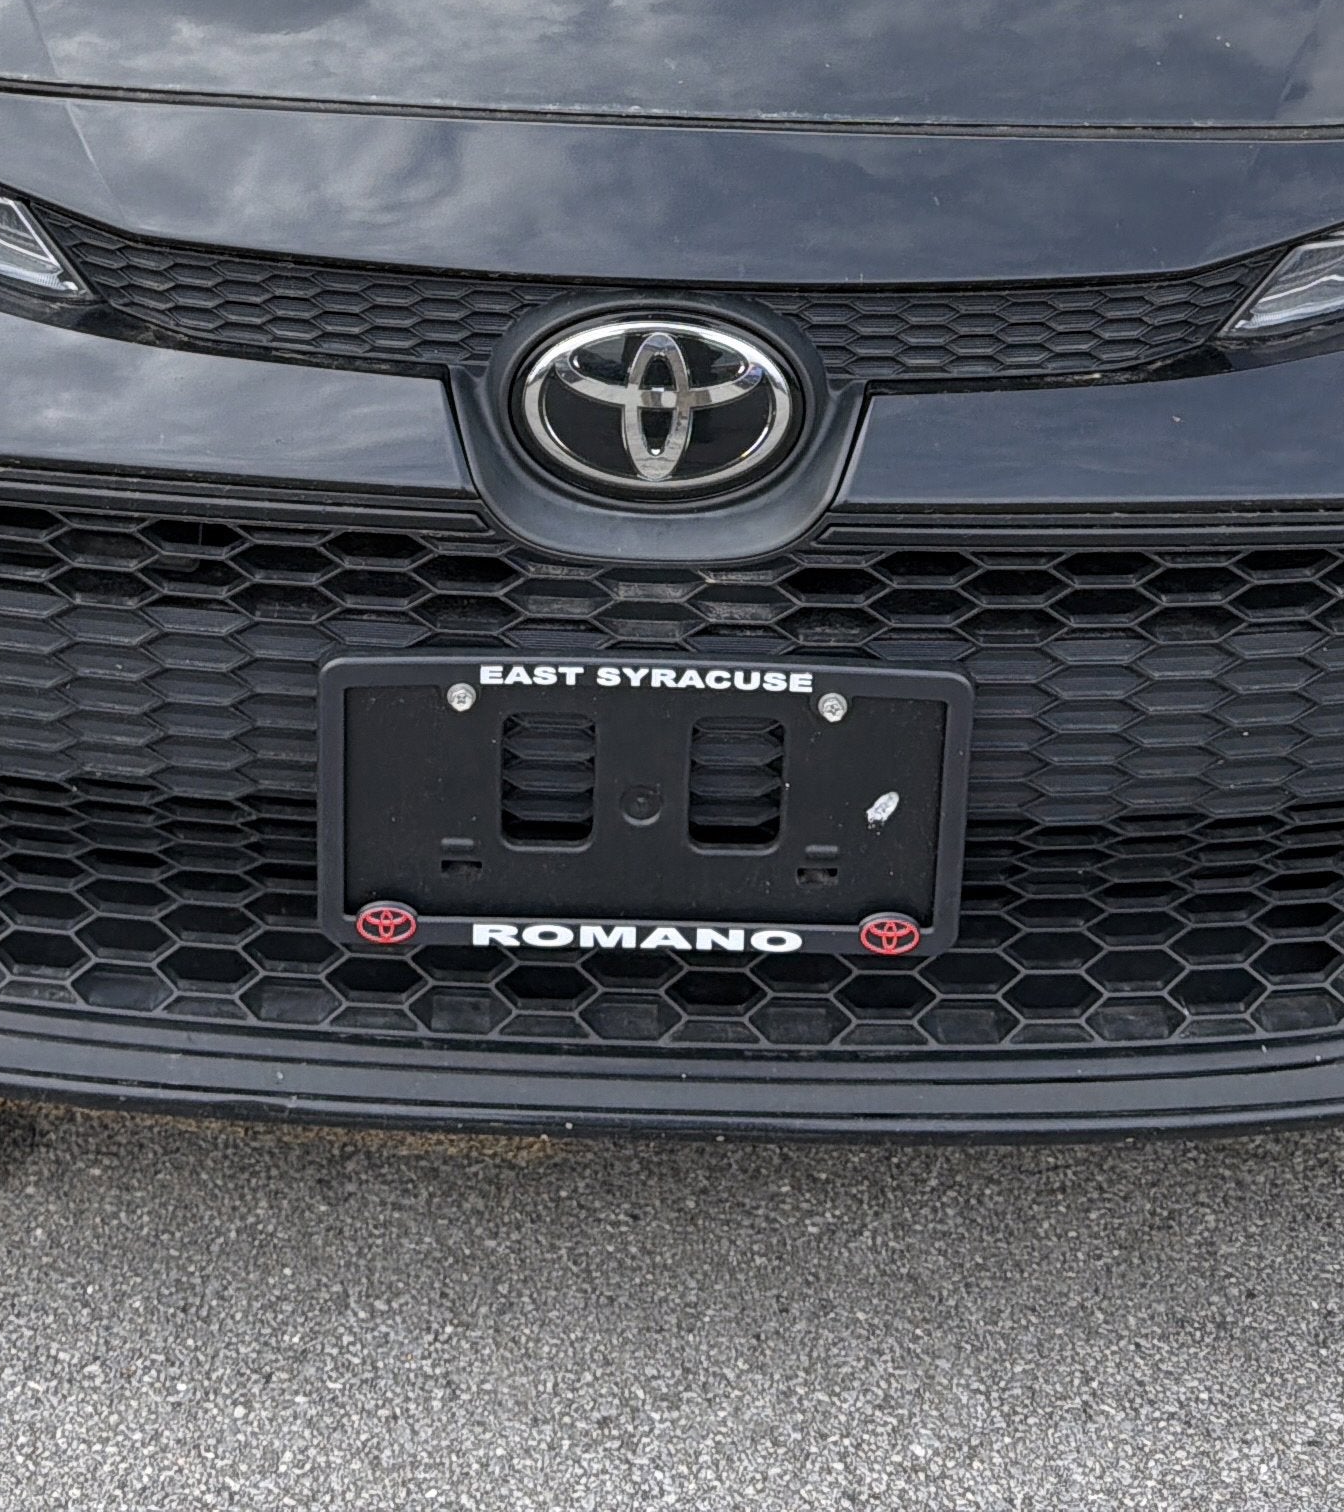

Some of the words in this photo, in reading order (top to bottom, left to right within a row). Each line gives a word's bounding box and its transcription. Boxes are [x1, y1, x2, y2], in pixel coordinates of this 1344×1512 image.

[479, 665, 584, 687] EAST
[596, 666, 814, 694] SYRACUSE
[471, 923, 803, 953] ROMANO
